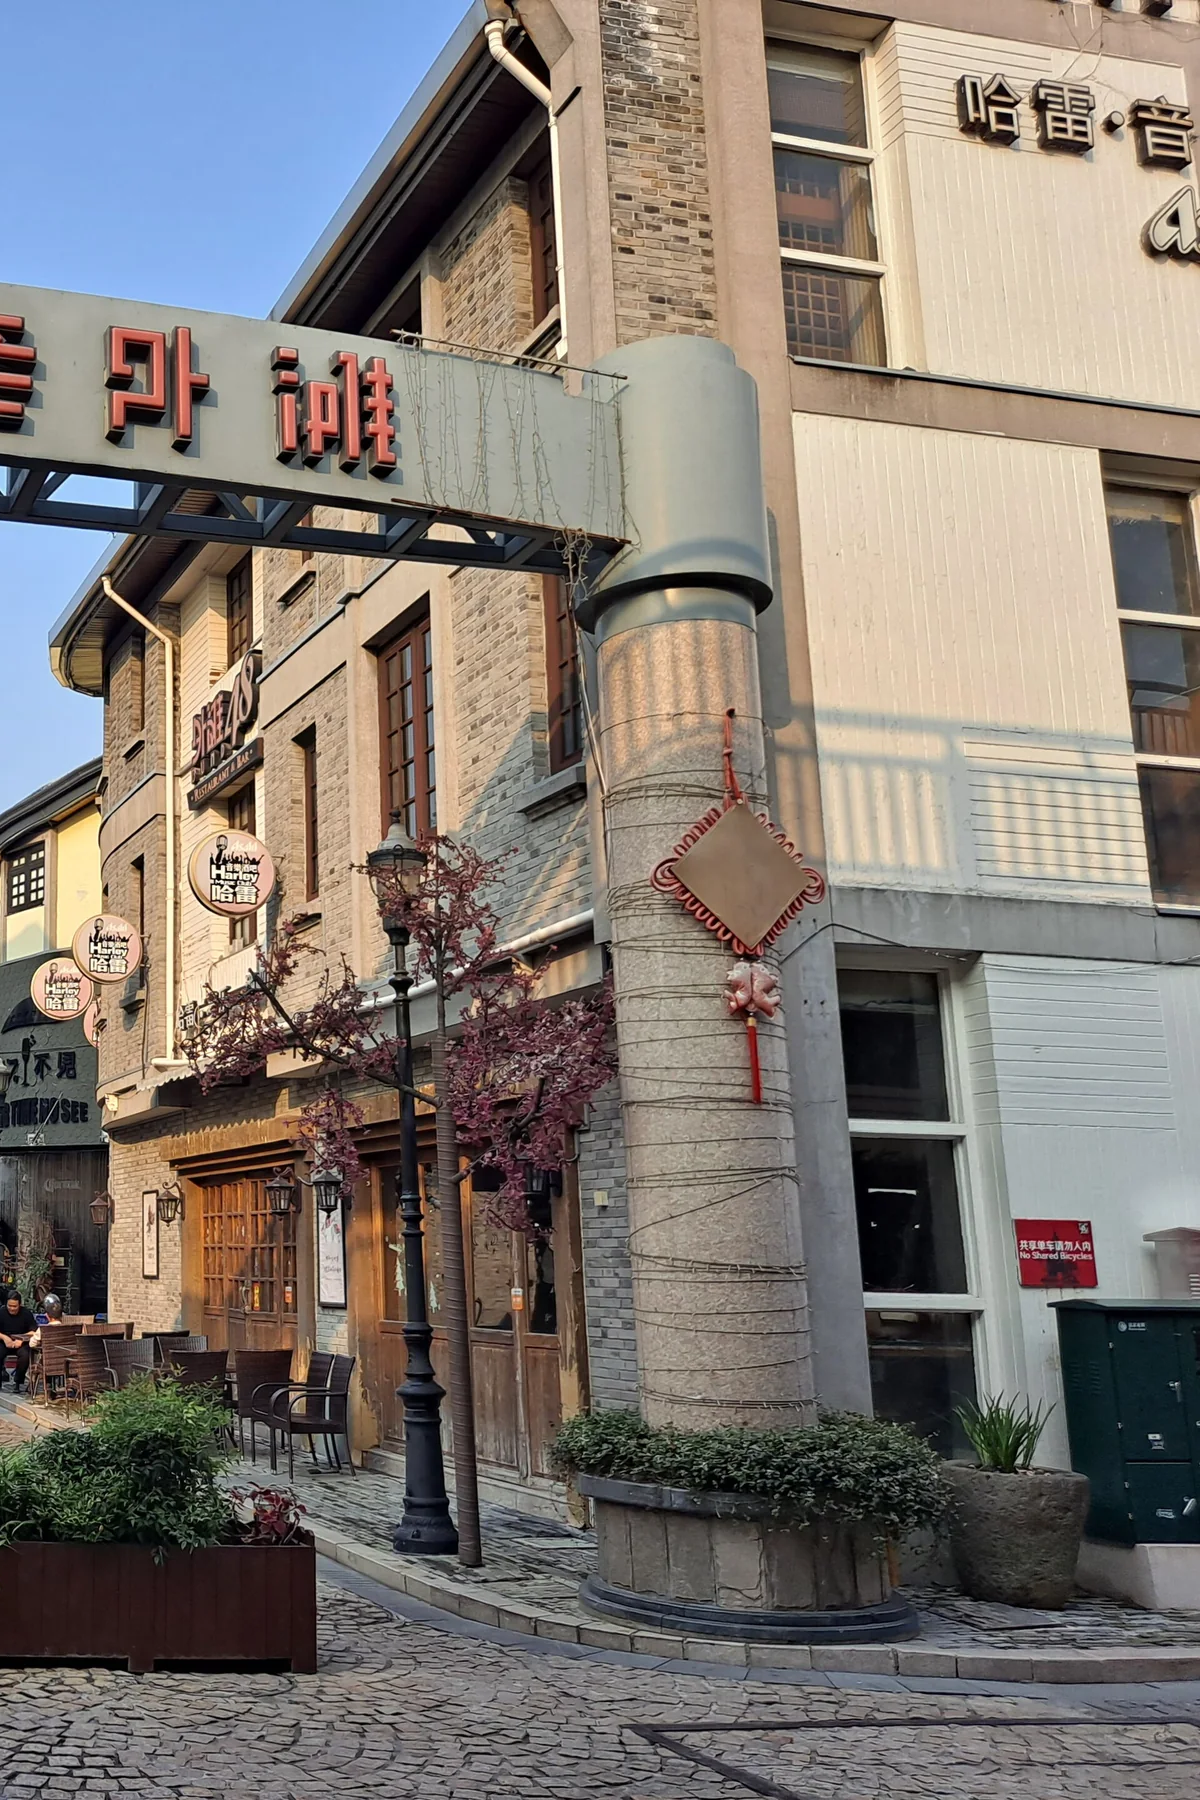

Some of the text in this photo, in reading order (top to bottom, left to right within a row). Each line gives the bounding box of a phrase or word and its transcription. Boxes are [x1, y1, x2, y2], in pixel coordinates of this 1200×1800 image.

[1141, 185, 1200, 262] A
[211, 864, 259, 883] Harley
[211, 885, 258, 903] 哈雷
[90, 942, 128, 957] Harley
[90, 958, 127, 974] 哈雷
[45, 983, 80, 996] Harley
[45, 997, 79, 1011] 哈雷
[61, 1098, 89, 1124] SEE
[1032, 1251, 1059, 1260] Shared
[1060, 1252, 1093, 1261] Bicycles
